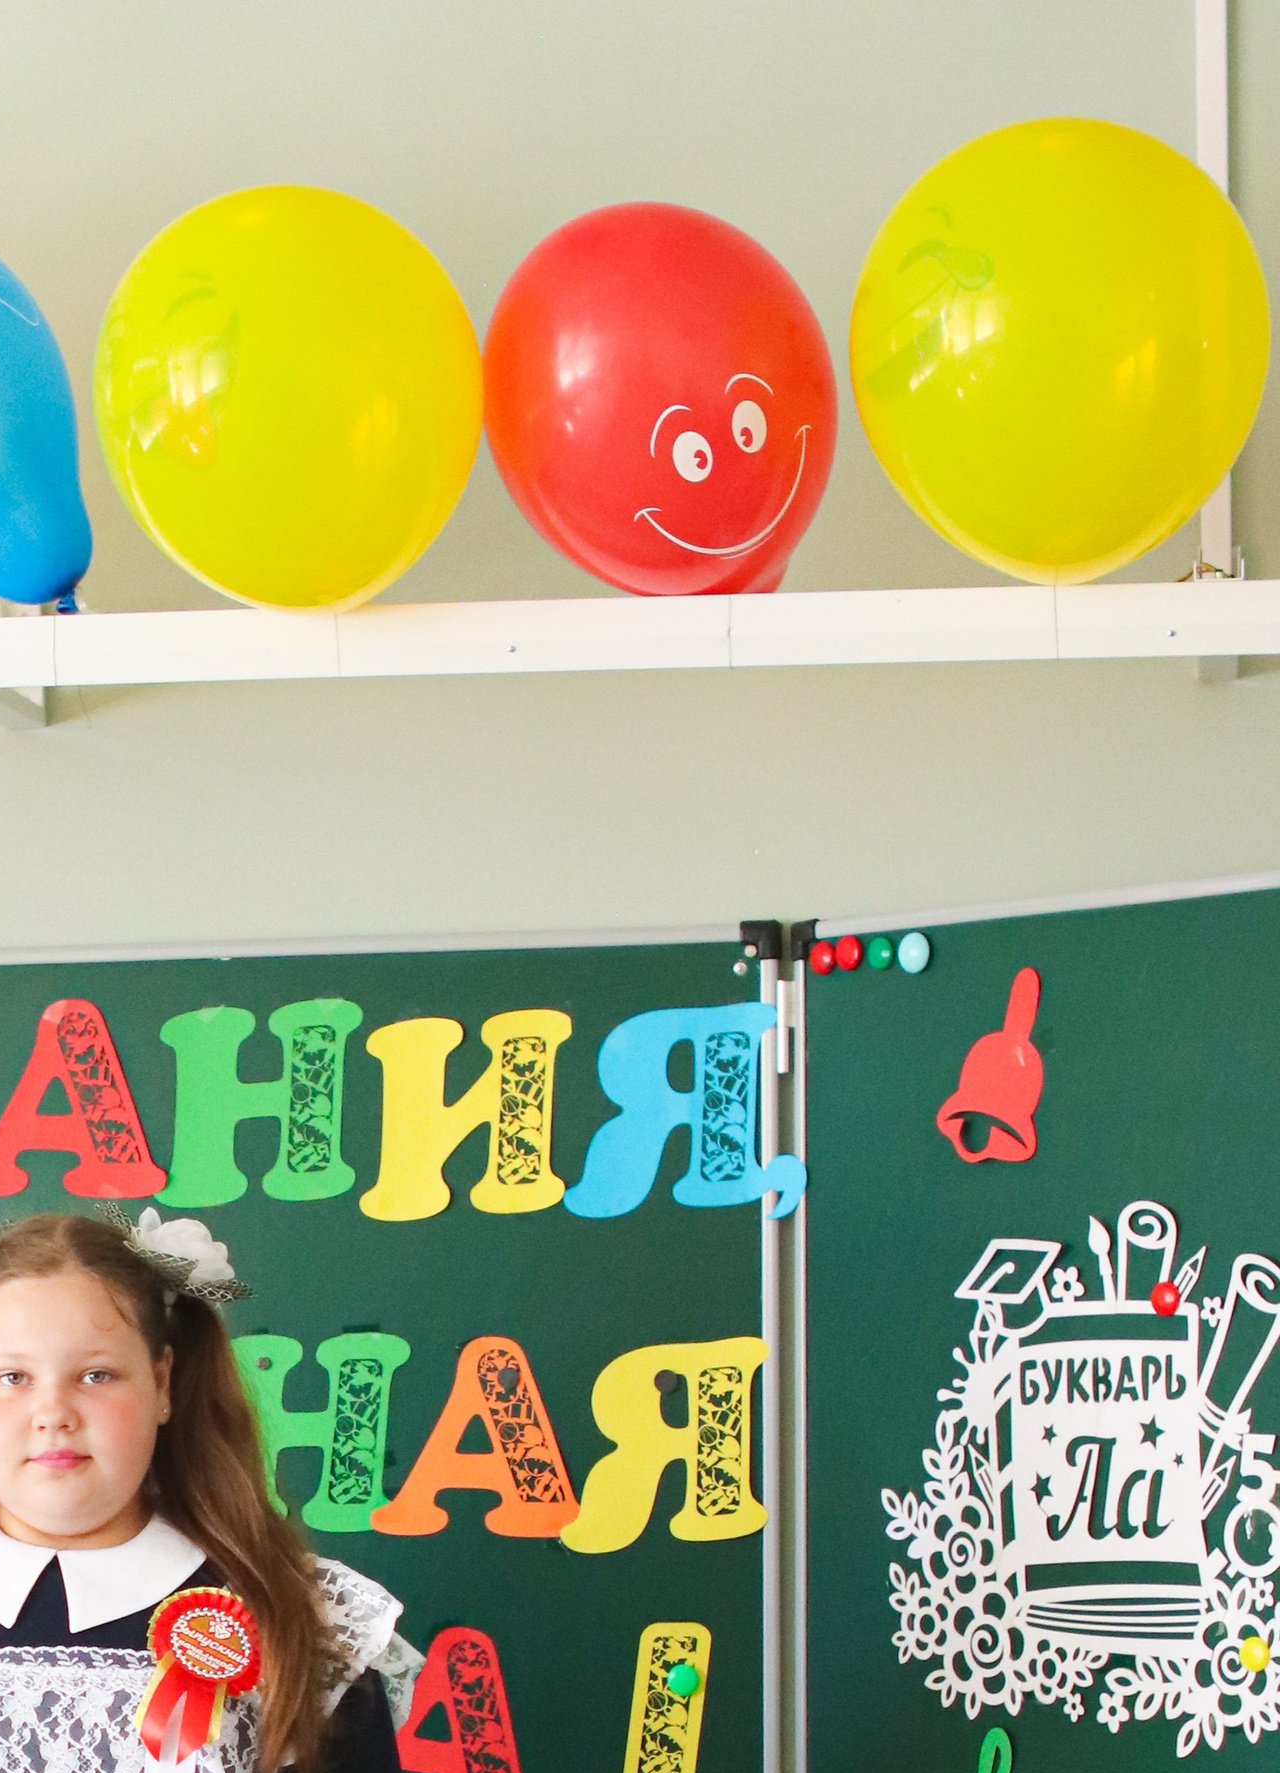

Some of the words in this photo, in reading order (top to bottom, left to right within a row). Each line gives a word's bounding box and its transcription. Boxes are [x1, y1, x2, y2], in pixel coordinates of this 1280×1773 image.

[1020, 1354, 1187, 1405] БУКВАРЬ
[1046, 1436, 1174, 1541] Аа
[171, 1618, 250, 1667] Выпускник
